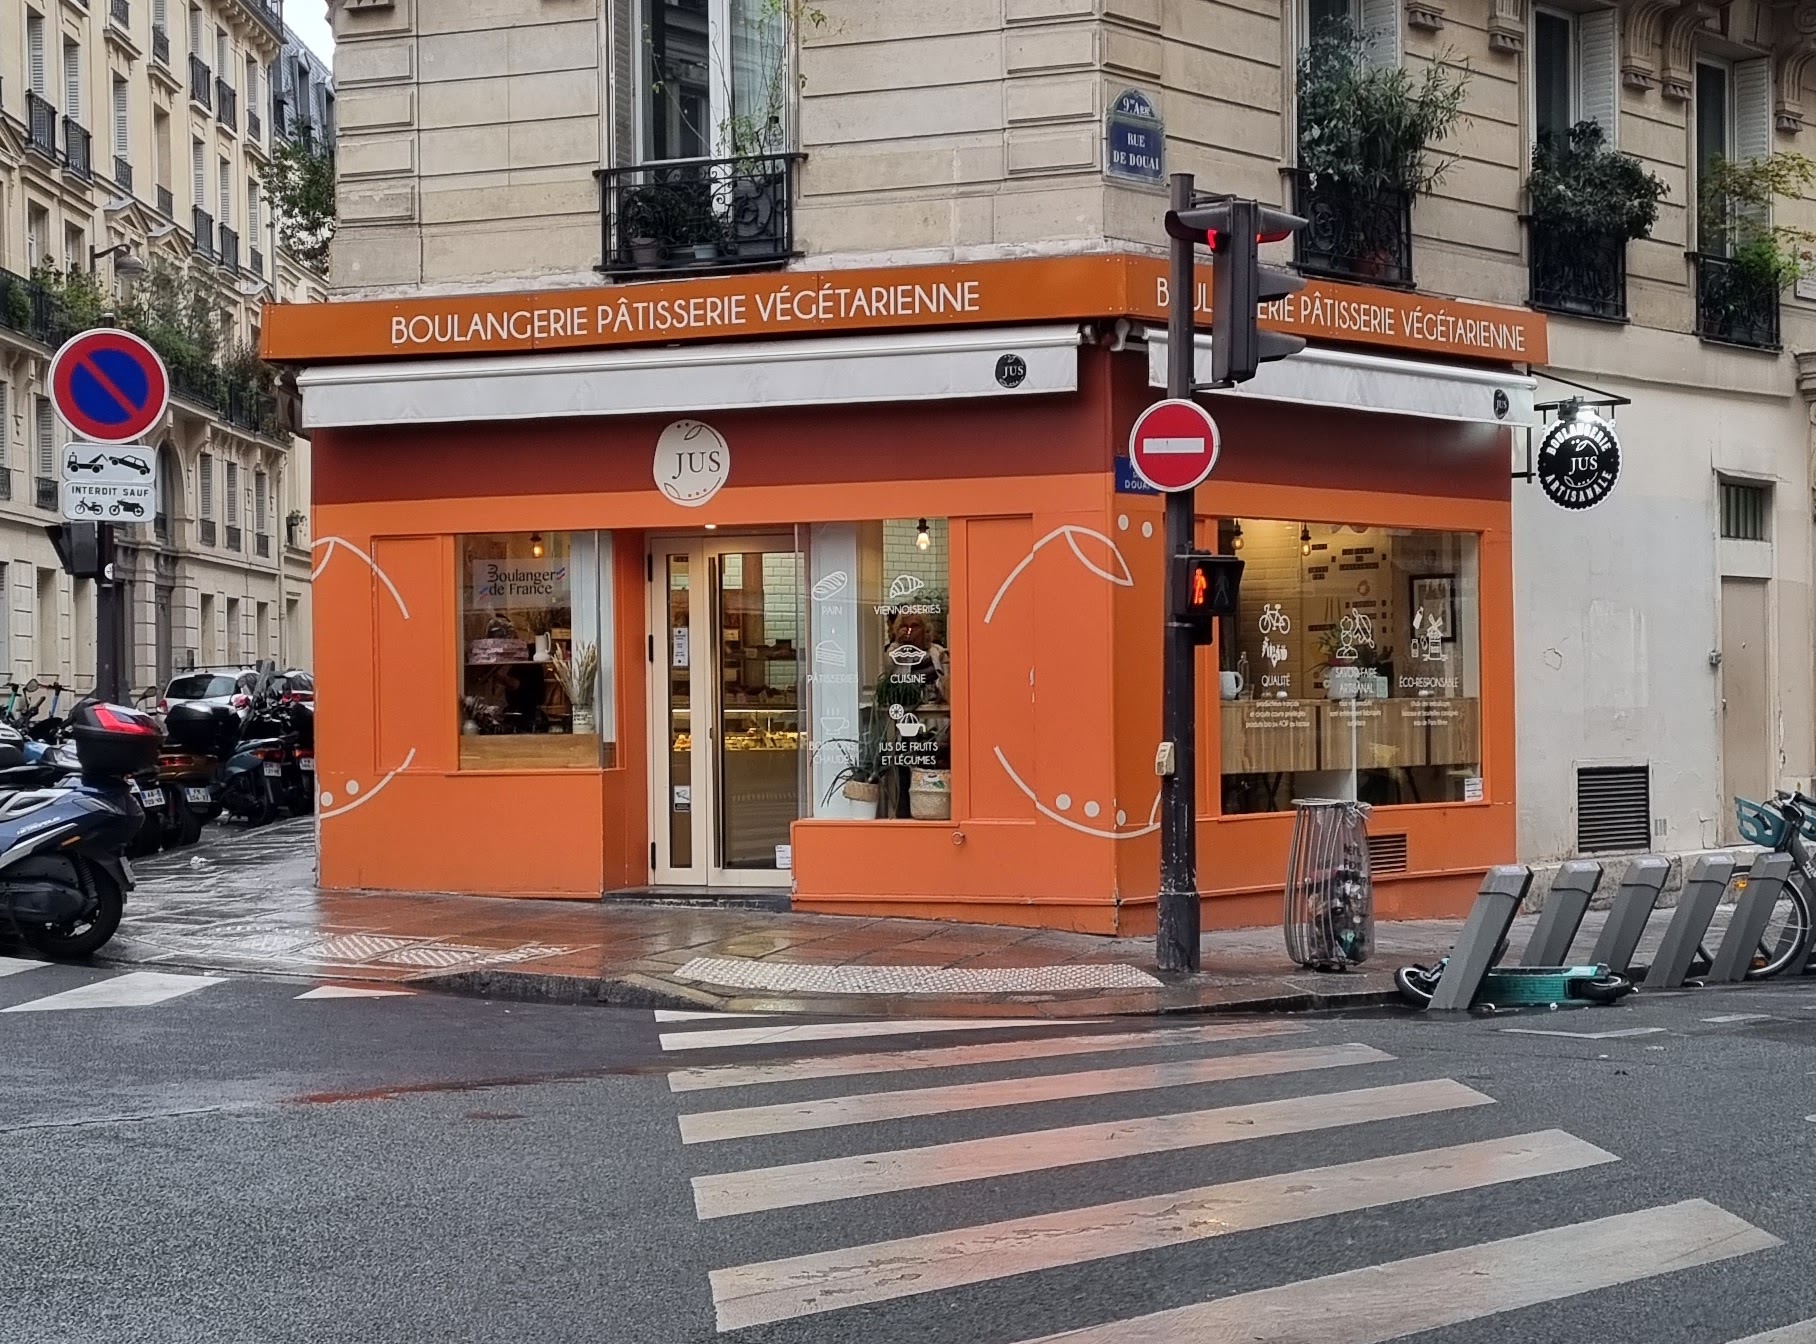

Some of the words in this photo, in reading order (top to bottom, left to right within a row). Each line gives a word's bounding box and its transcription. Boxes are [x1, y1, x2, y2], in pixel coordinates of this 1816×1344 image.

[1127, 132, 1145, 148] RUE
[1113, 150, 1127, 165] DE
[1129, 153, 1160, 171] DOUAI
[391, 306, 588, 344] BOULANGERIE
[597, 294, 747, 334] PÂTISSERIE
[755, 281, 980, 322] VÉGÉTARIENNE
[1300, 291, 1395, 335] PÂTISSERIE
[1401, 307, 1525, 352] VÉGÉTARIENNE
[1002, 365, 1024, 379] JUS
[671, 450, 721, 480] JUS
[1568, 456, 1598, 475] JUS
[71, 485, 118, 496] INTERDIT
[123, 488, 149, 497] SAUF
[1124, 479, 1151, 490] DOUA
[1545, 470, 1612, 502] ARTISANALE
[487, 563, 556, 585] Boulanger
[489, 583, 505, 596] de
[509, 583, 553, 596] France
[821, 605, 843, 616] PAIN
[873, 604, 941, 615] VIENNOISERIES
[890, 673, 927, 684] CUISINE
[1261, 672, 1290, 687] QUALITÉ
[1399, 674, 1459, 688] ÉCO-RESPONSABLE
[808, 740, 856, 751] BOSSONS
[879, 741, 894, 753] JUS
[896, 741, 908, 752] DE
[910, 741, 939, 752] FRUITS
[882, 756, 893, 766] ET
[894, 754, 937, 766] LÉGUMES
